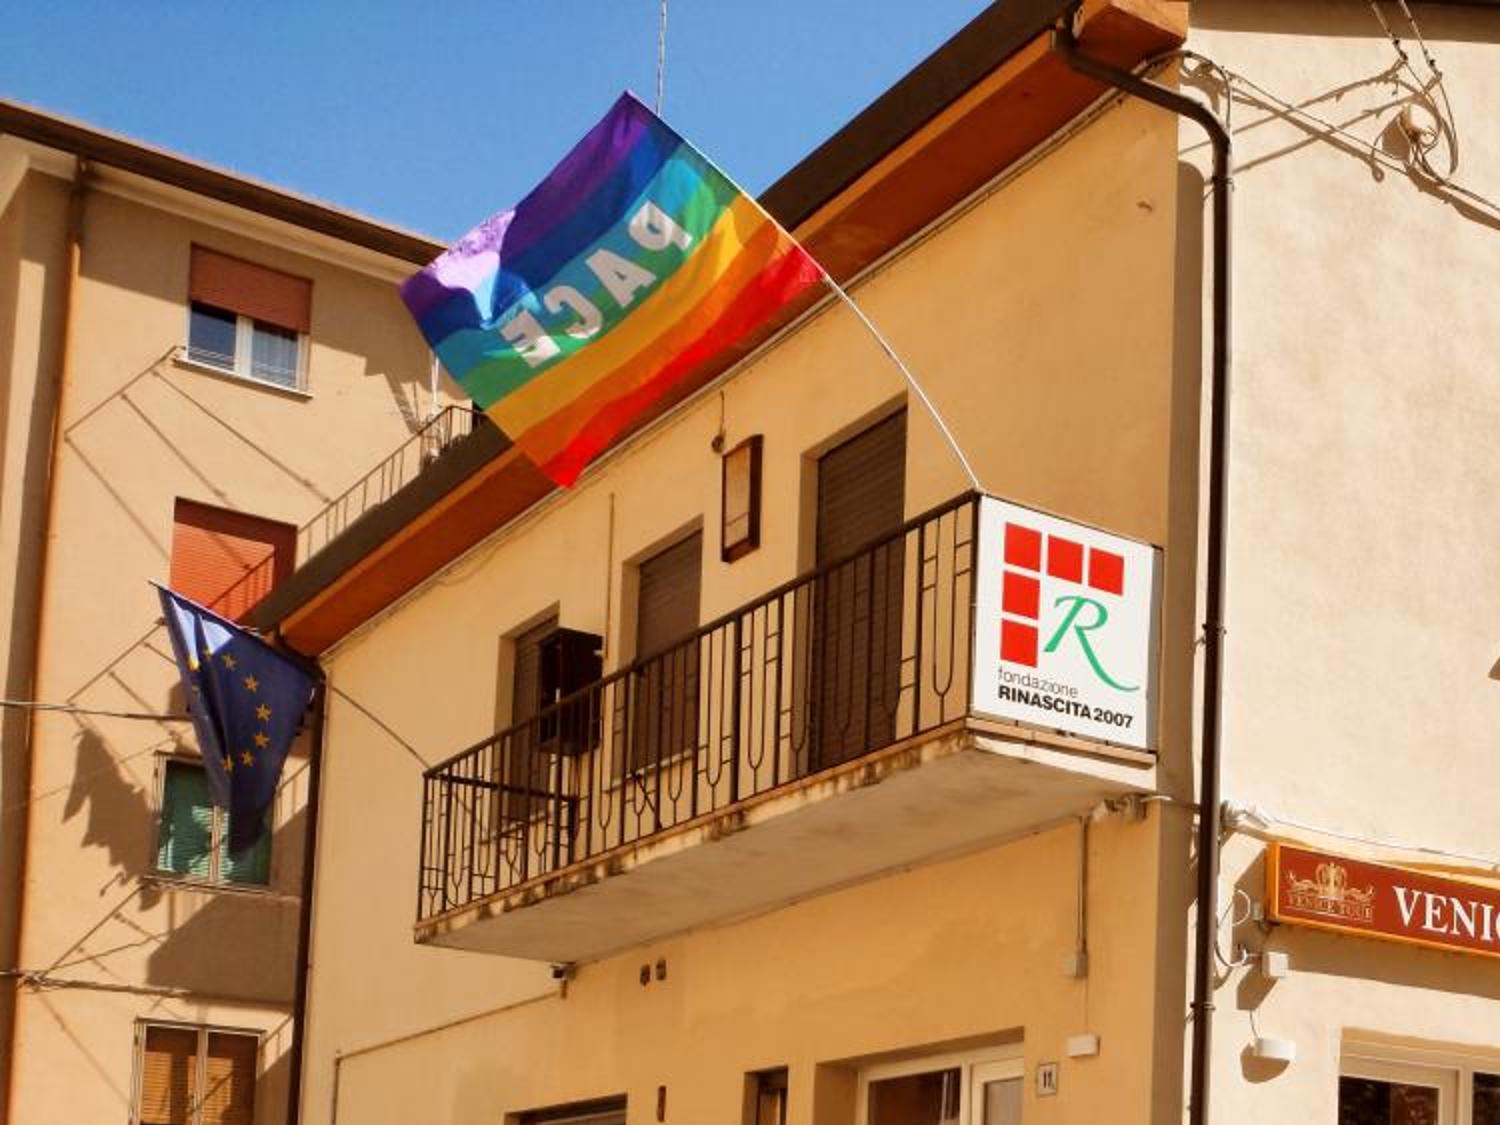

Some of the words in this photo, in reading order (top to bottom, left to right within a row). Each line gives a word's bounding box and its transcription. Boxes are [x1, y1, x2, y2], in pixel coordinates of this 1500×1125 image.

[998, 666, 1078, 697] fondazione
[998, 685, 1091, 719] RINASCITA
[1093, 706, 1133, 728] 2007
